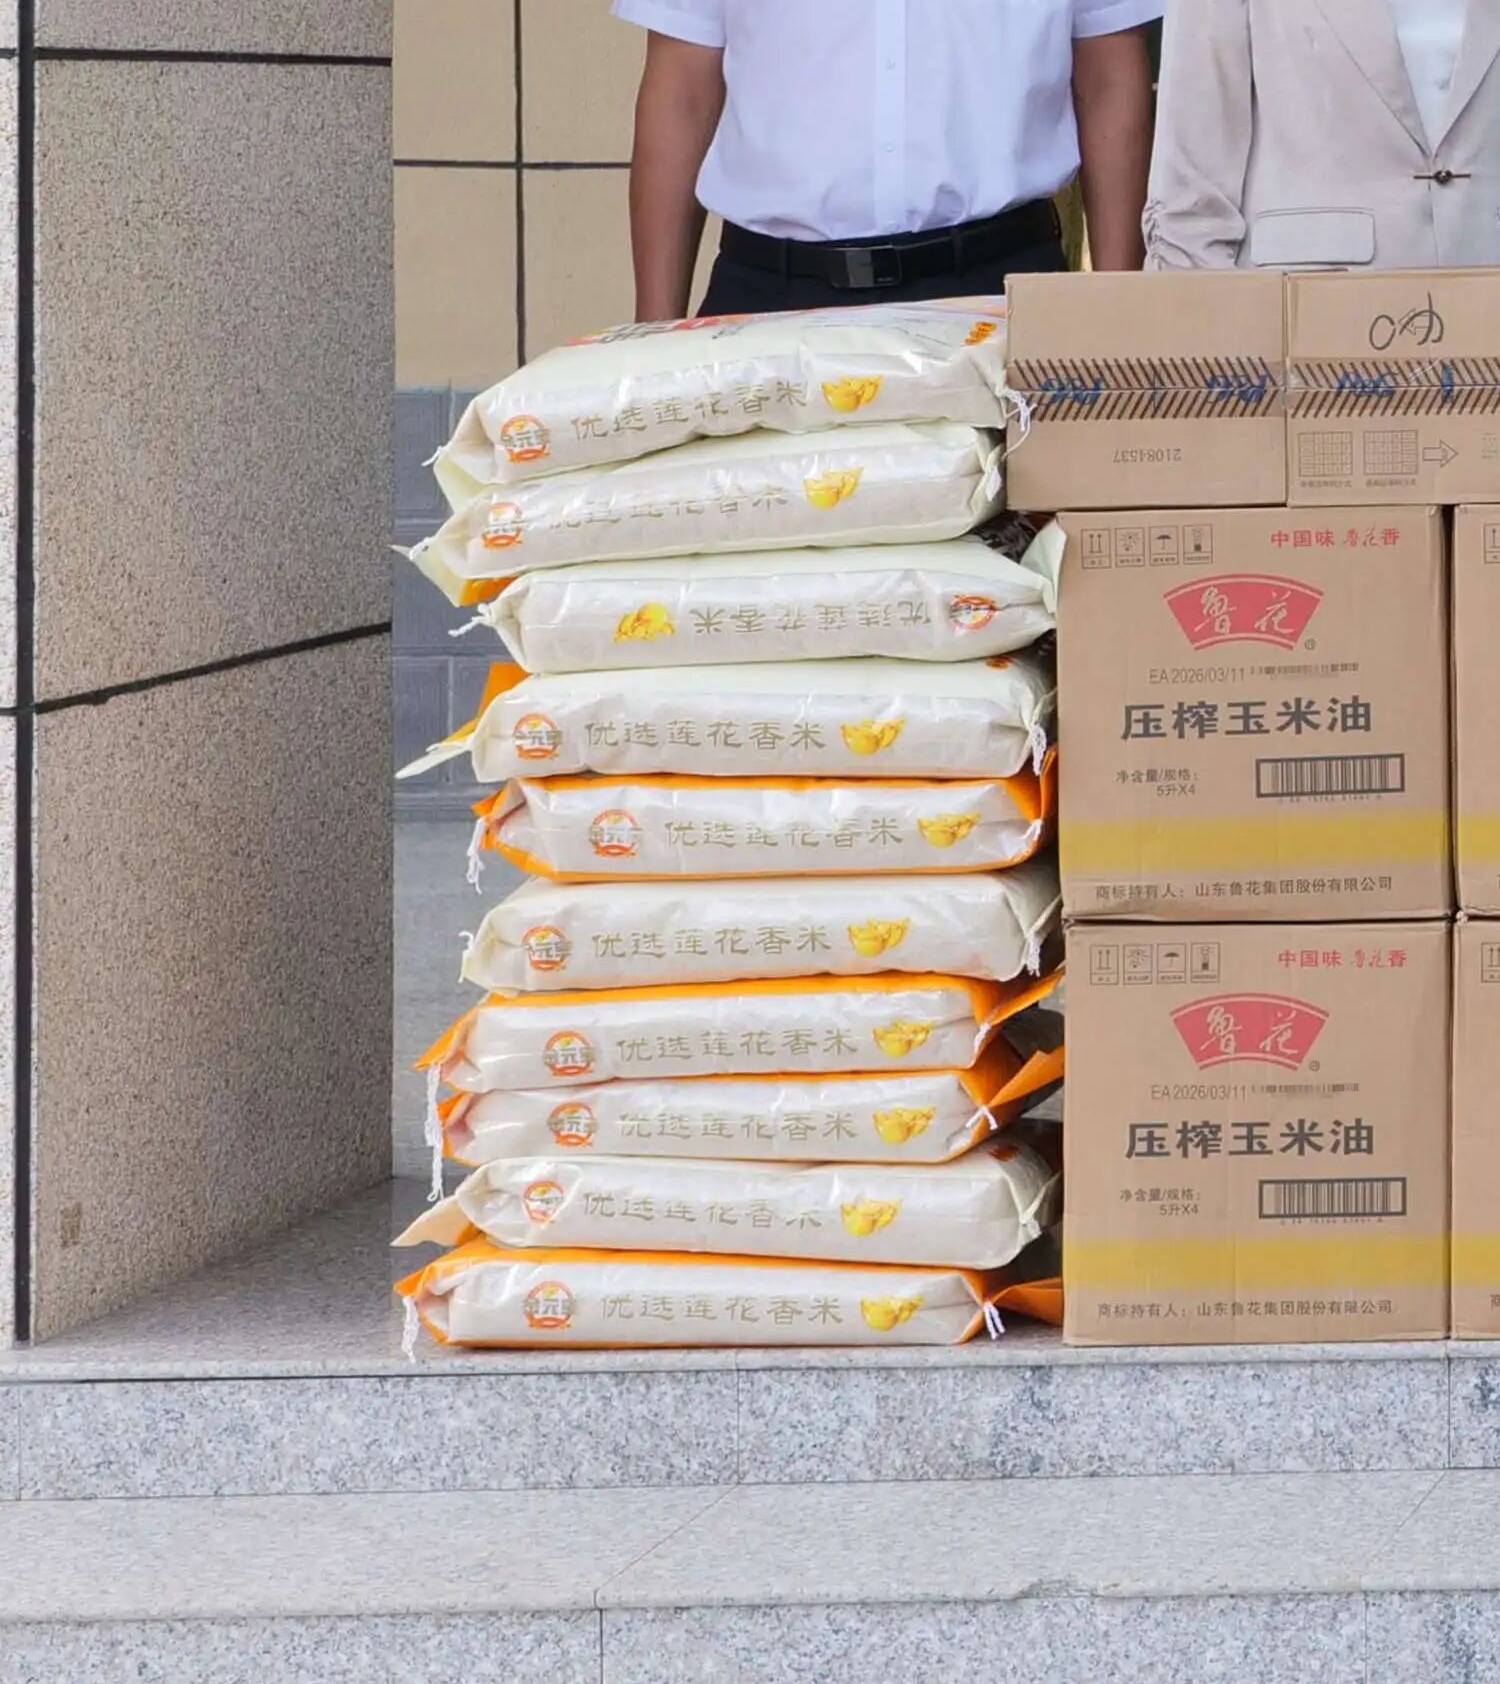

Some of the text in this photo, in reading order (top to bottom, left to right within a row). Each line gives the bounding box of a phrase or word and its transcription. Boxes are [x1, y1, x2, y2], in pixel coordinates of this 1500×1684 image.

[585, 719, 827, 751] 优选莲花香米
[1120, 695, 1372, 741] 压榨玉米油
[592, 923, 832, 959] 优选莲花香米
[617, 1027, 859, 1063] 优选莲花香米
[1125, 1118, 1374, 1160] 压榨玉米油
